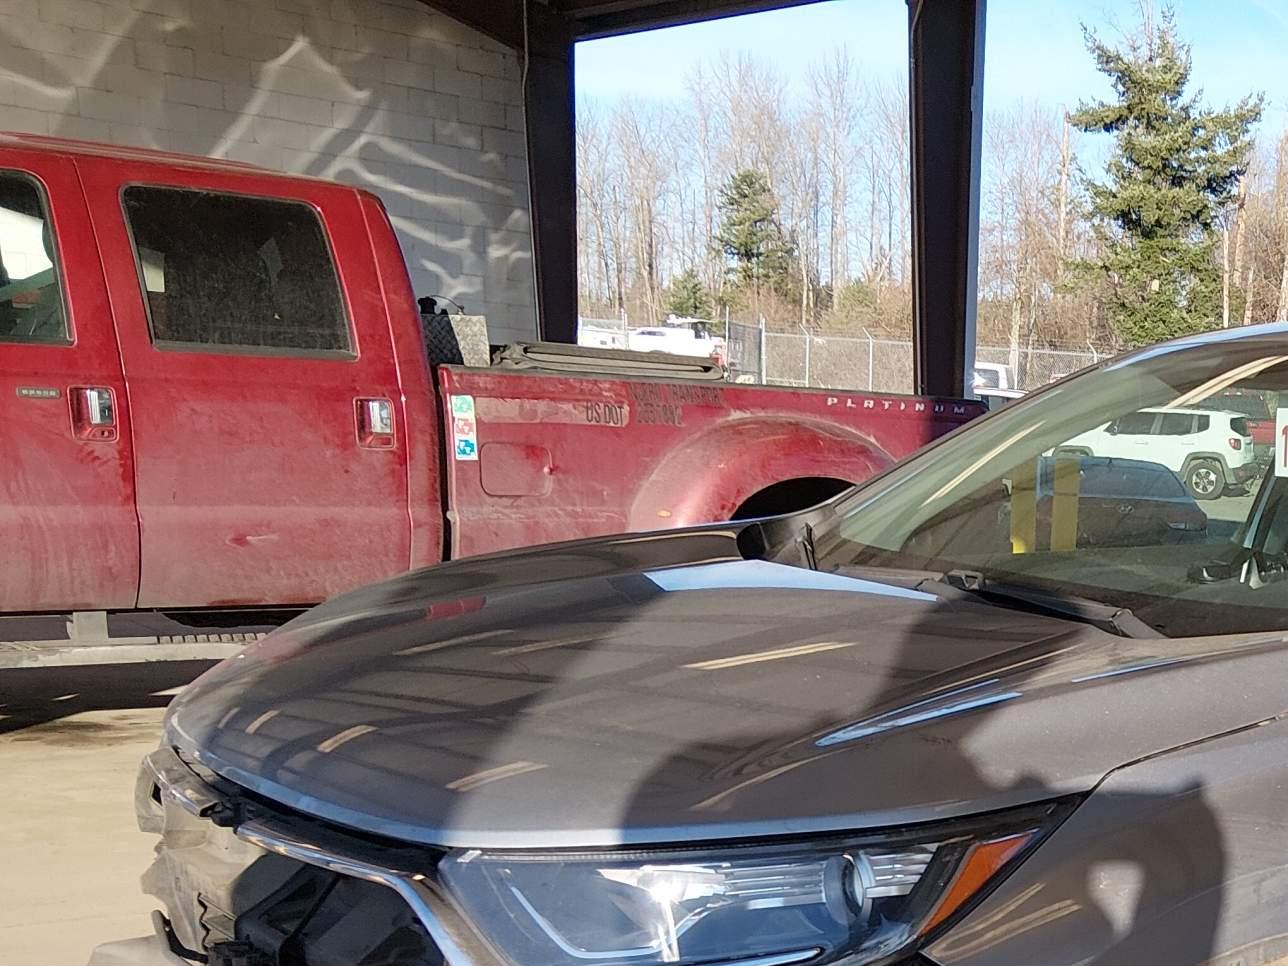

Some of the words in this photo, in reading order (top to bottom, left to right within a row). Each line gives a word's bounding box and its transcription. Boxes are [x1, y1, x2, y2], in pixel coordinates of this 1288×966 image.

[586, 401, 600, 423] US
[604, 404, 625, 426] DOT
[827, 397, 965, 414] PLATINUM
